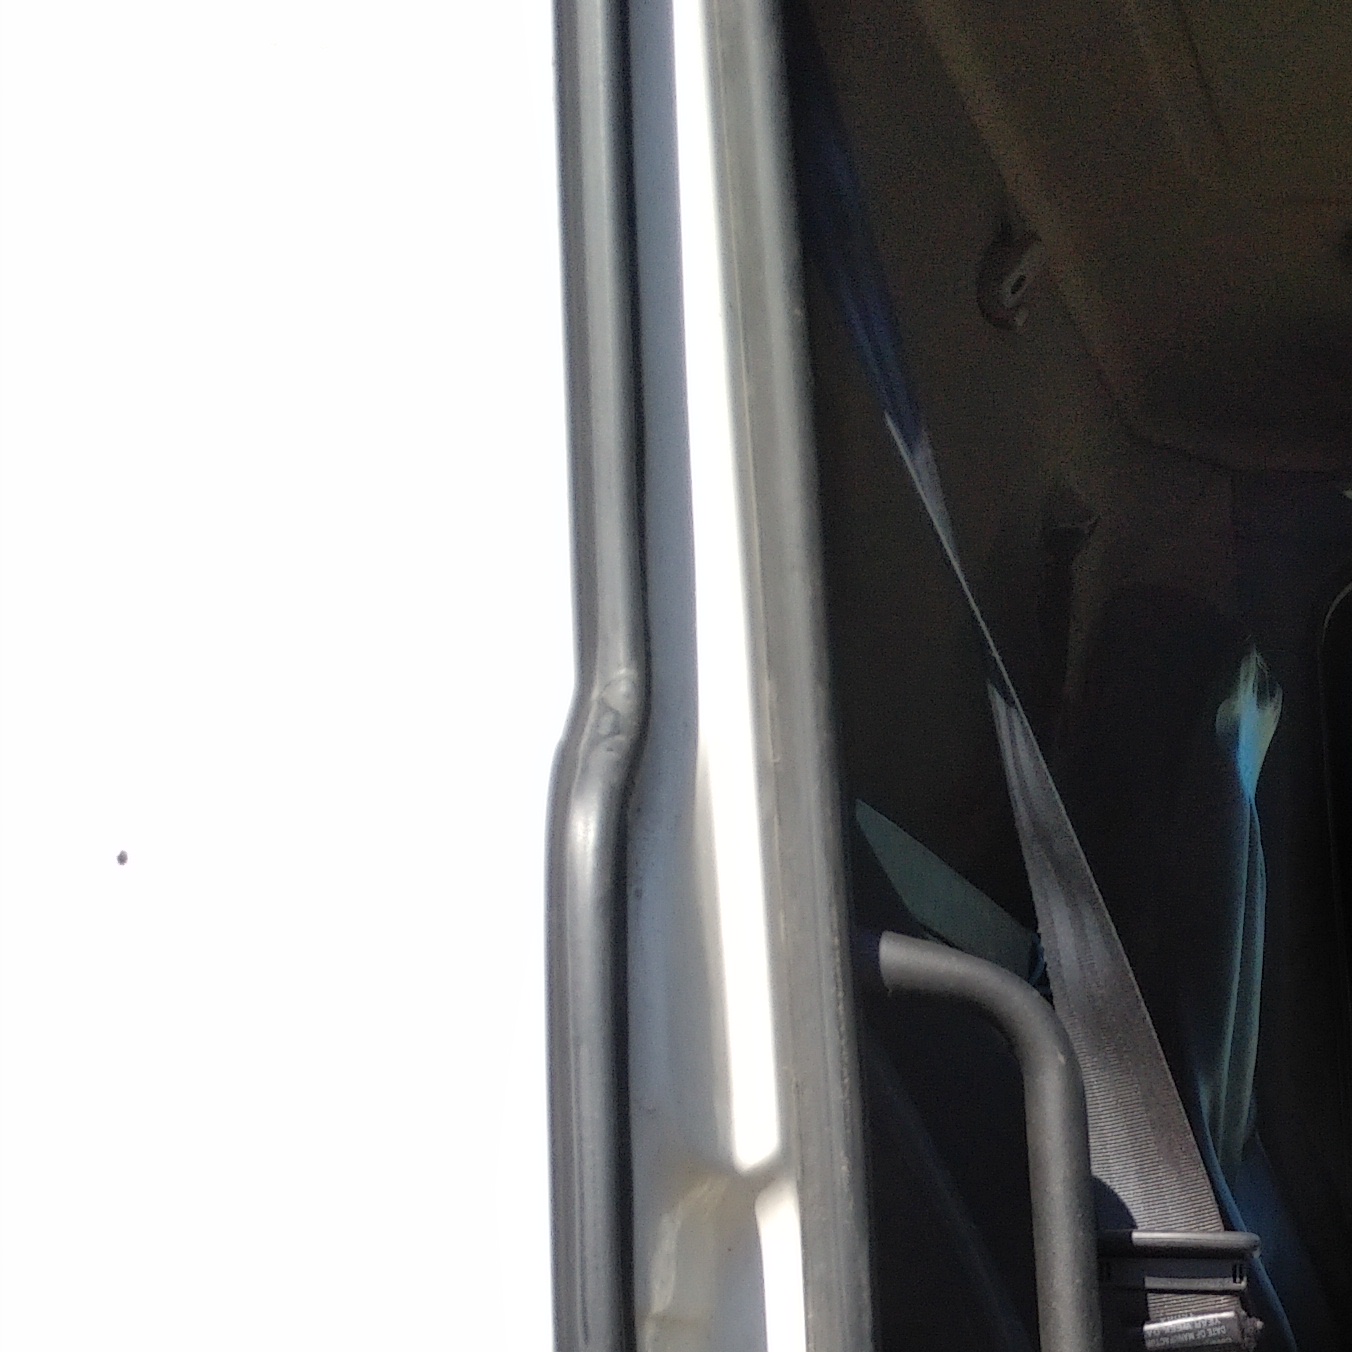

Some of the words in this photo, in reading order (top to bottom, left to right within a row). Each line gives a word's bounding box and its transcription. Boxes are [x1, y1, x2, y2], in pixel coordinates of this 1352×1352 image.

[1194, 1318, 1222, 1331] YEAR
[1206, 1324, 1227, 1338] DATE
[1195, 1328, 1206, 1340] OF
